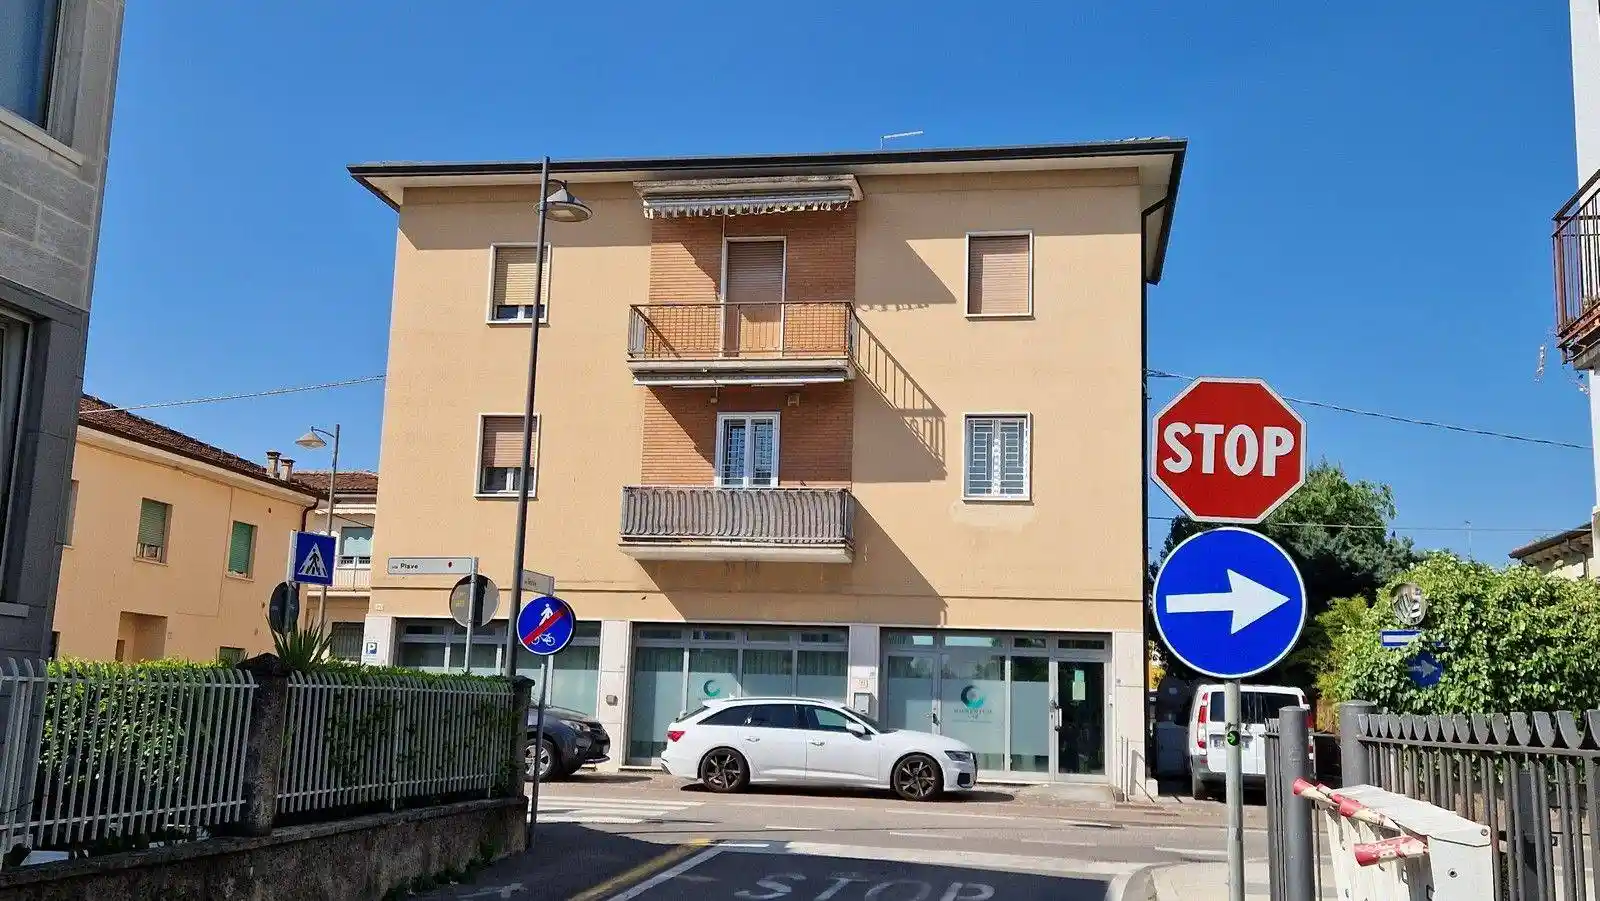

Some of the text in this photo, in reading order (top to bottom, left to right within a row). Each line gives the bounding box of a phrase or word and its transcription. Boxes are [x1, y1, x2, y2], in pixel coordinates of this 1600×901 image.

[1163, 421, 1295, 477] STOP
[400, 562, 419, 570] Piave
[734, 871, 996, 901] STOP
